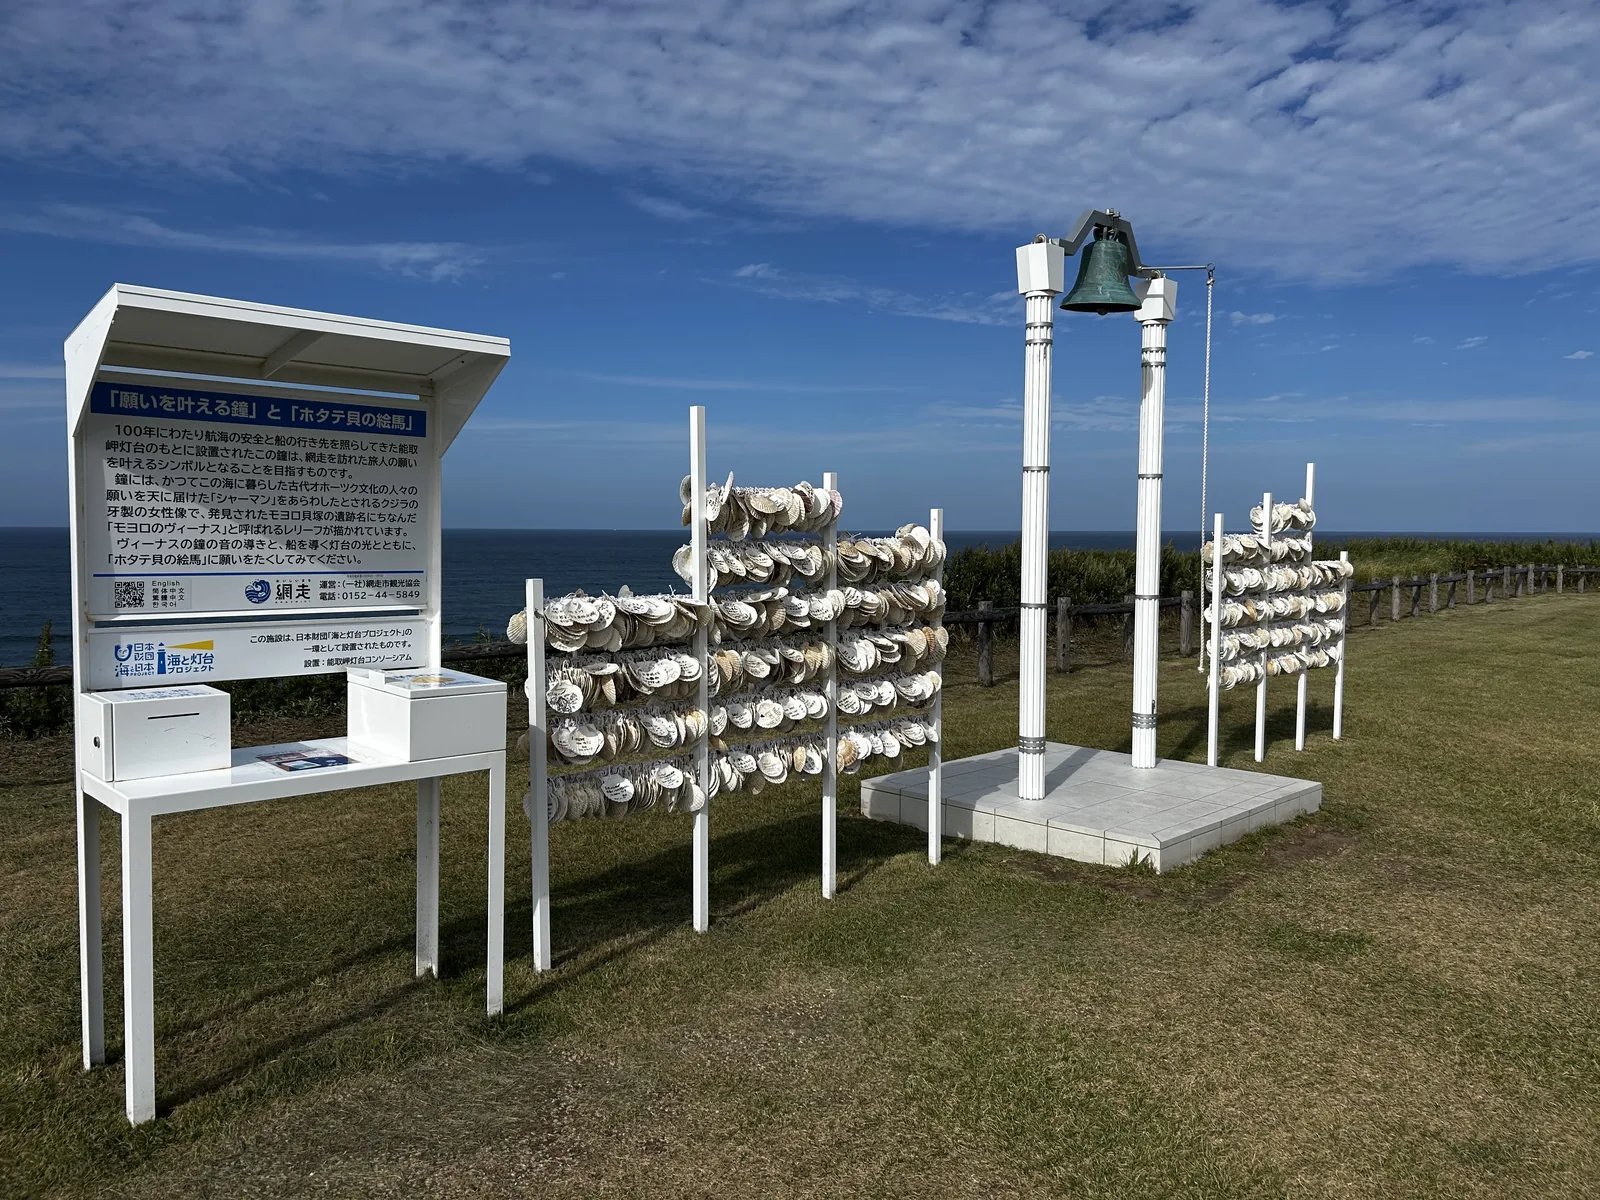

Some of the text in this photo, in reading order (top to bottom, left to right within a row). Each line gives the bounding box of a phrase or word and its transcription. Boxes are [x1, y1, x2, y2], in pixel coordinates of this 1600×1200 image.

[115, 424, 418, 455] 100年にわたり航海の安全と船の行き先を照らしてきた能取
[105, 439, 418, 468] 岬灯台のもとに設置されたこの鐘は、網走を訪れた旅人の願い
[106, 456, 353, 480] を叶えるシンボルとなることを目指すものです。
[114, 473, 418, 496] 鐘には、かつてこの海に暮らした古代オホーツク文化の人々の
[106, 489, 419, 510] 願いを天に届けた「シャーマン」をあらわしたとされるクジラの
[106, 505, 417, 523] 牙製の女性像で、発見されたモヨロ貝塚の遺跡名にちなんだ
[107, 521, 408, 537] 「モヨロのヴィーナス」と呼ばれるレリーフが描かれています。
[116, 537, 417, 551] ヴィーナスの鐘の音の導きと、船を導く灯台の光とともに、
[108, 553, 362, 566] 「ホタテ貝の絵馬」に願いをたくしてみてください。
[275, 583, 311, 600] 網走
[250, 628, 413, 644] この施設は、日本財団「海と灯台プロジェクト」の
[303, 641, 412, 653] 一環として設置されたものです。
[167, 652, 215, 666] 海と灯台
[167, 665, 215, 674] プロジェクト
